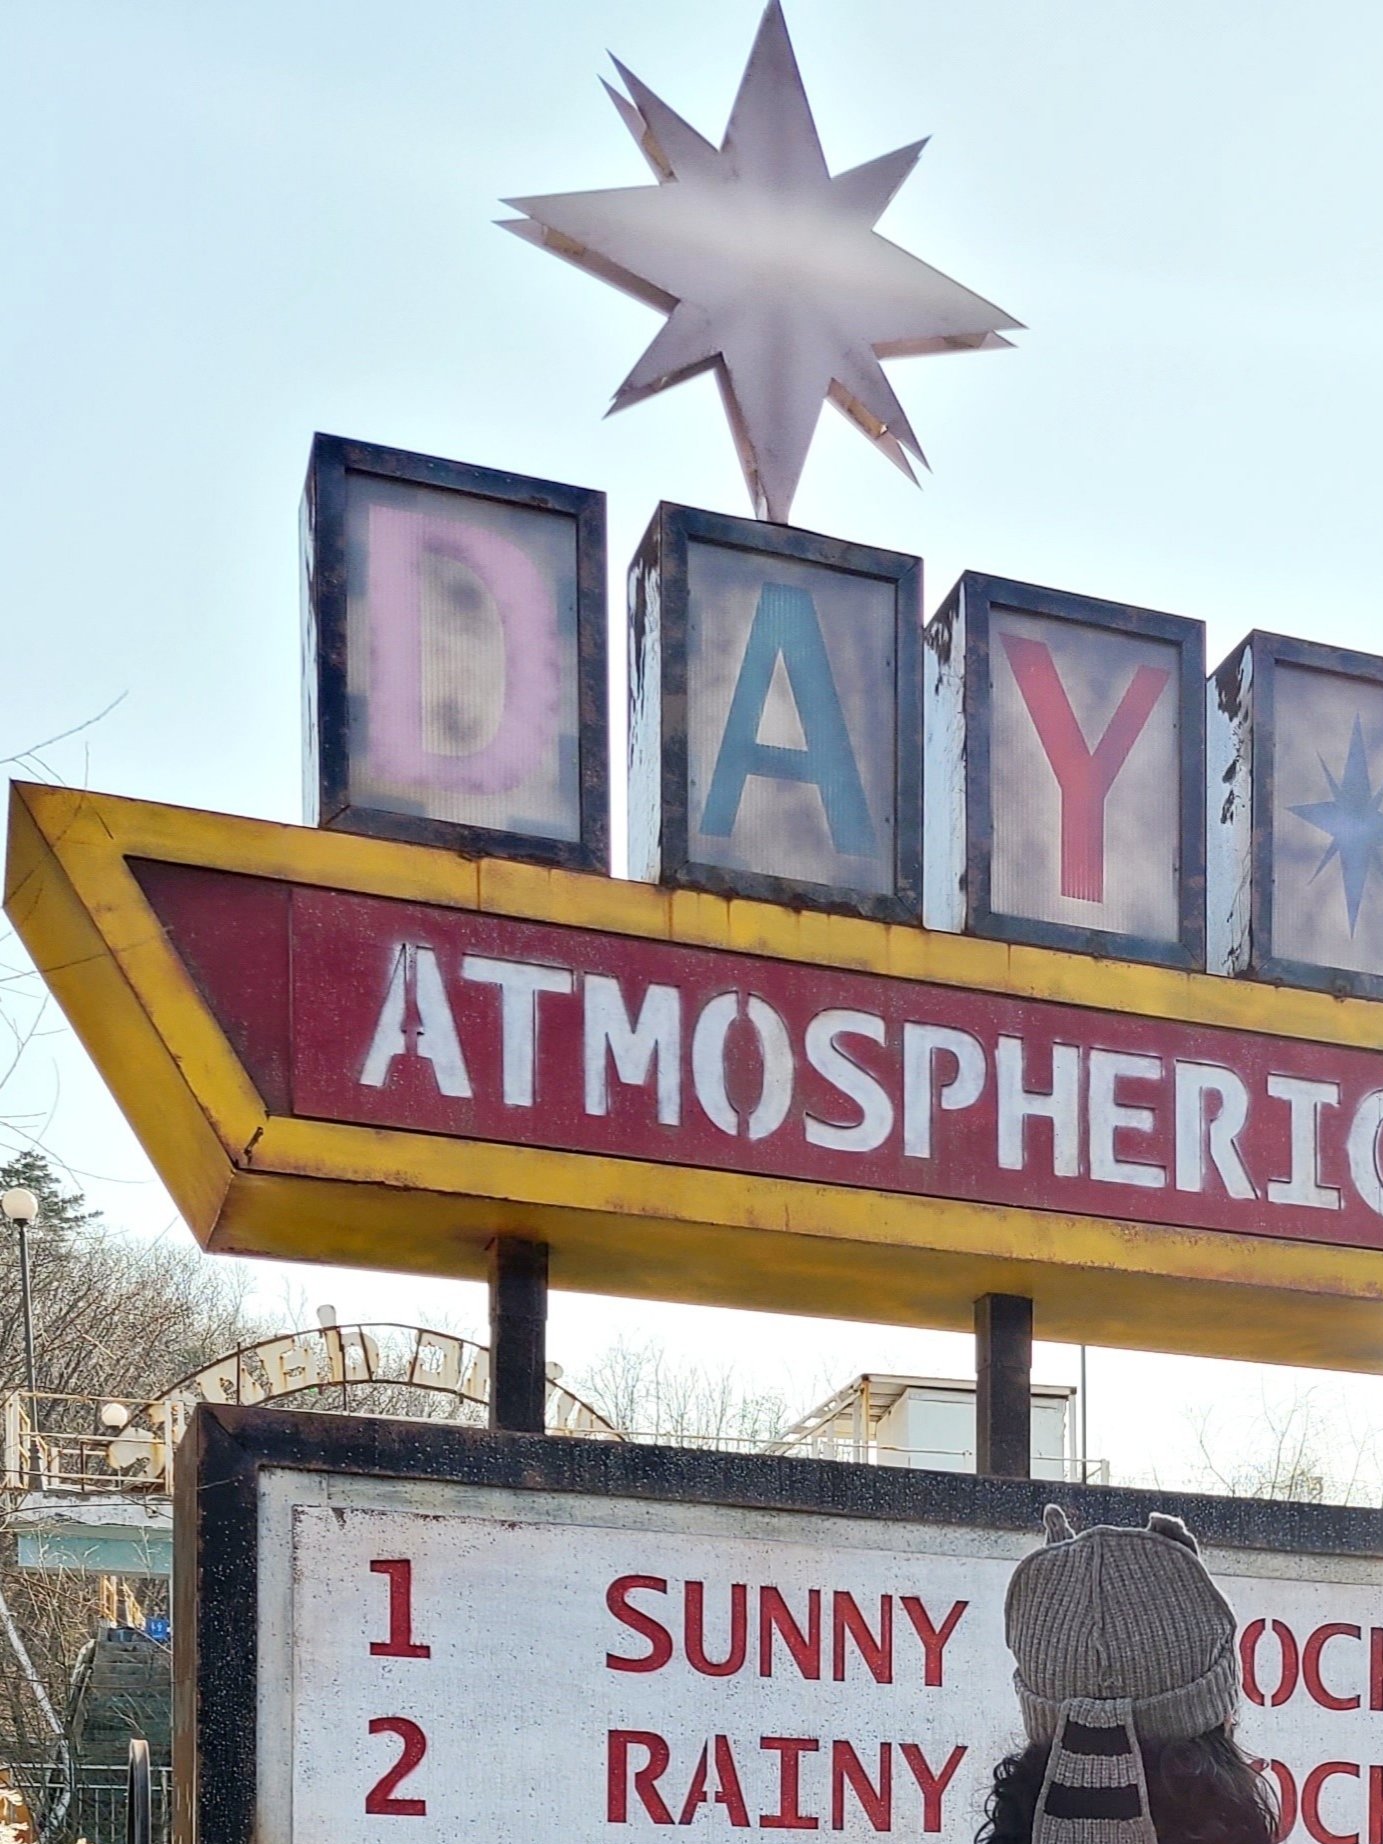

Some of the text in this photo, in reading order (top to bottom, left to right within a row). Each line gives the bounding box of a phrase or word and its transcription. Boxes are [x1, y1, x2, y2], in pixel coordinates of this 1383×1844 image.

[366, 503, 1171, 904] DAY
[369, 1558, 431, 1660] 1
[604, 1574, 969, 1688] SUNNY
[364, 1715, 428, 1818] 2
[606, 1728, 968, 1834] RAINY
